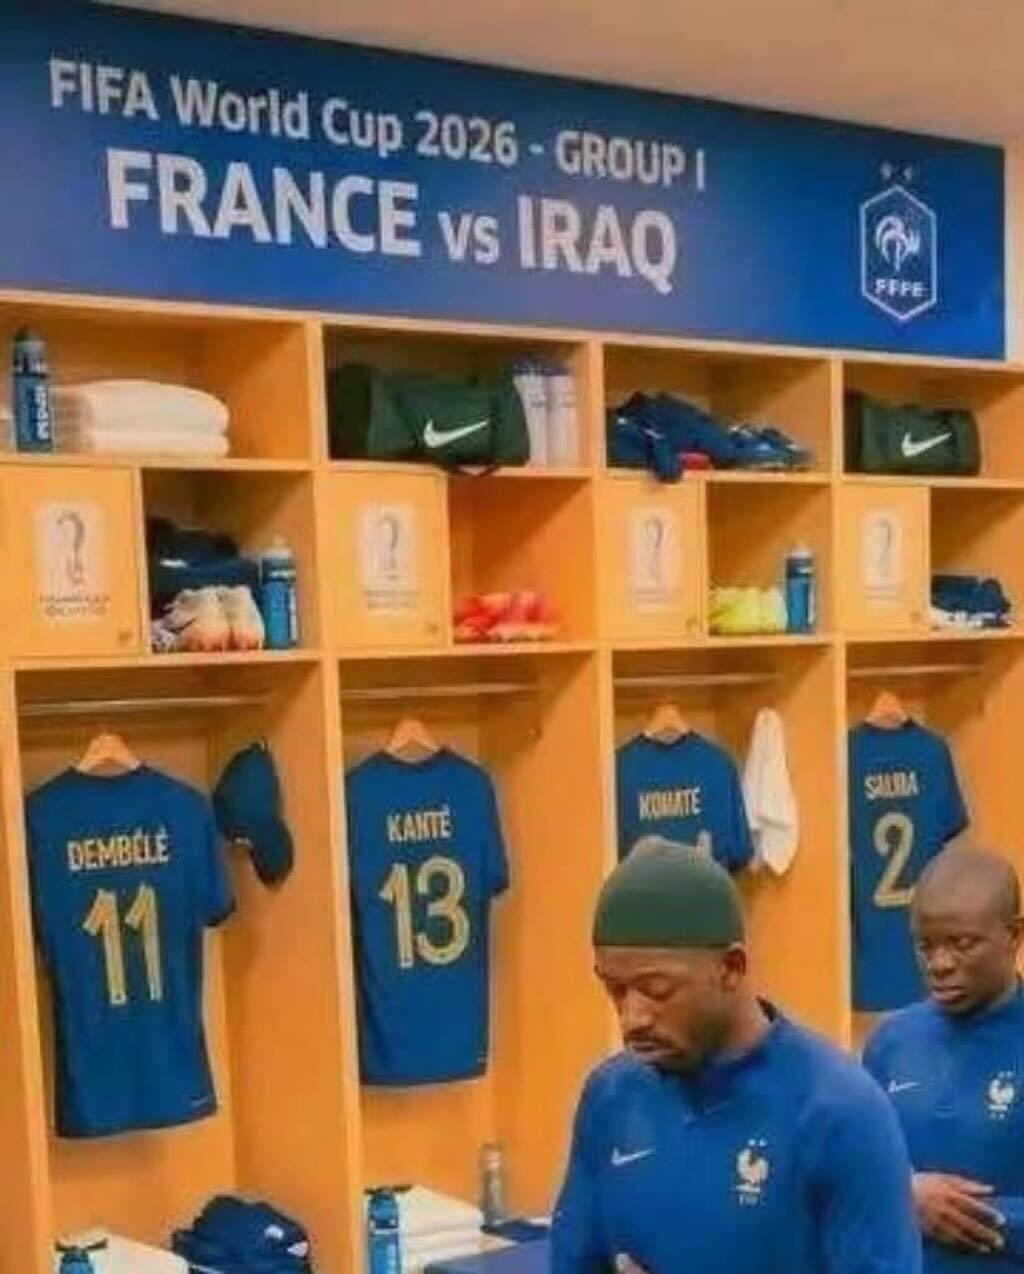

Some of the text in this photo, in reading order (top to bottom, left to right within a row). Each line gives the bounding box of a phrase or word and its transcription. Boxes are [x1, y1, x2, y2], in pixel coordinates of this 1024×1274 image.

[49, 58, 705, 191] FIFA World Cup 2026 - GROUP I
[106, 147, 677, 294] FRANCE vs IRAQ
[378, 856, 470, 969] 13
[872, 811, 915, 907] 2
[82, 881, 163, 1005] 11
